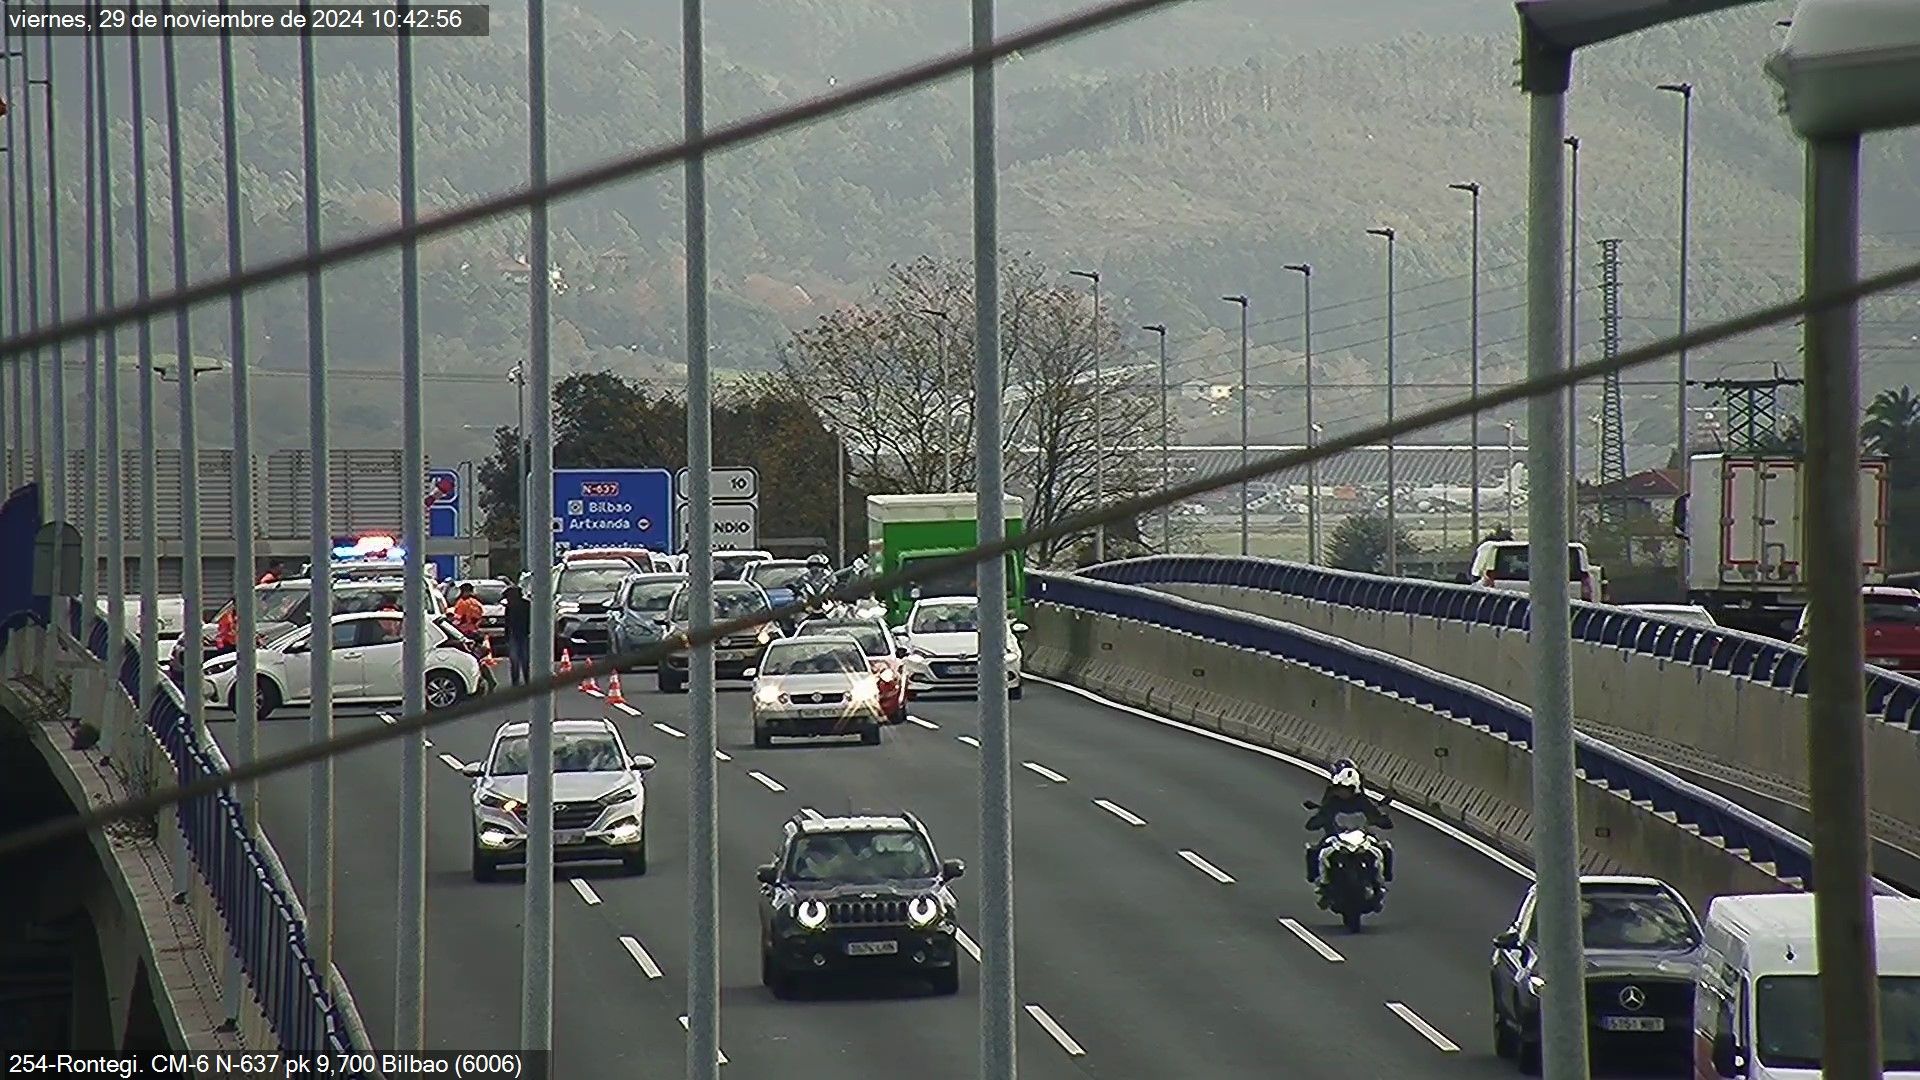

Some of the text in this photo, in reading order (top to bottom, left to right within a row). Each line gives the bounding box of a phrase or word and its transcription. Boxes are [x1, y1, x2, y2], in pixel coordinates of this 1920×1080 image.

[583, 484, 616, 494] N-637
[731, 478, 747, 490] 10
[589, 501, 632, 513] Bilbao
[569, 518, 630, 530] Artxanda
